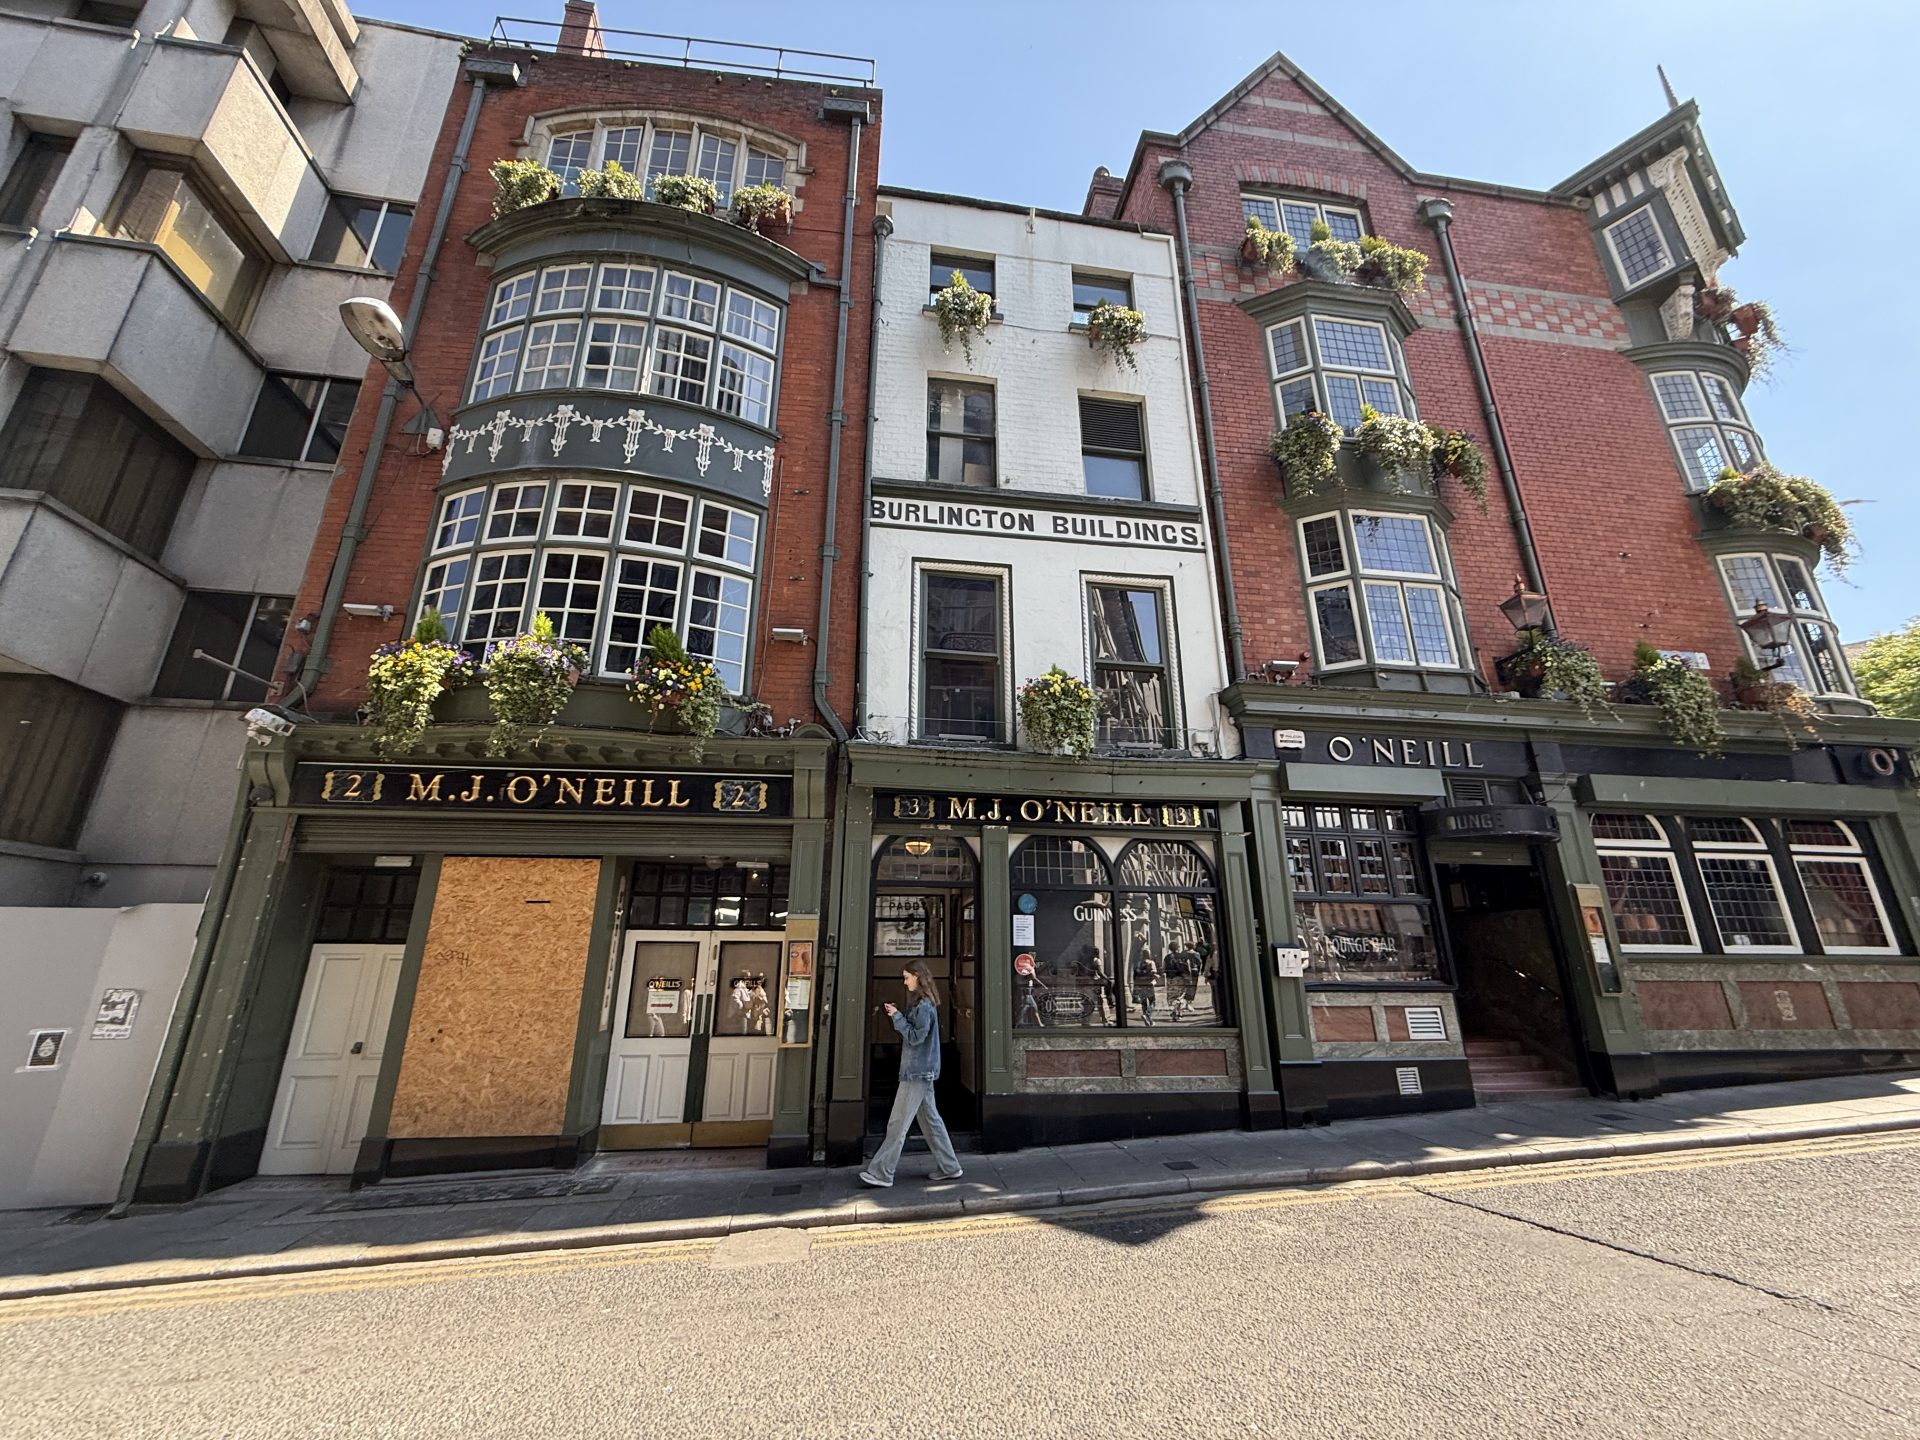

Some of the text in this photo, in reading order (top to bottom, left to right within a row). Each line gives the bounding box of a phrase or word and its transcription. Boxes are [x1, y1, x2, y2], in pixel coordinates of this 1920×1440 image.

[871, 500, 1035, 532] BURLINGTON
[1328, 736, 1484, 769] O'NEILL
[343, 773, 745, 807] 2 M.J. O'NEILL 2
[908, 797, 1187, 824] 3 M.J. O'NEILL 3
[1372, 937, 1396, 952] BAR
